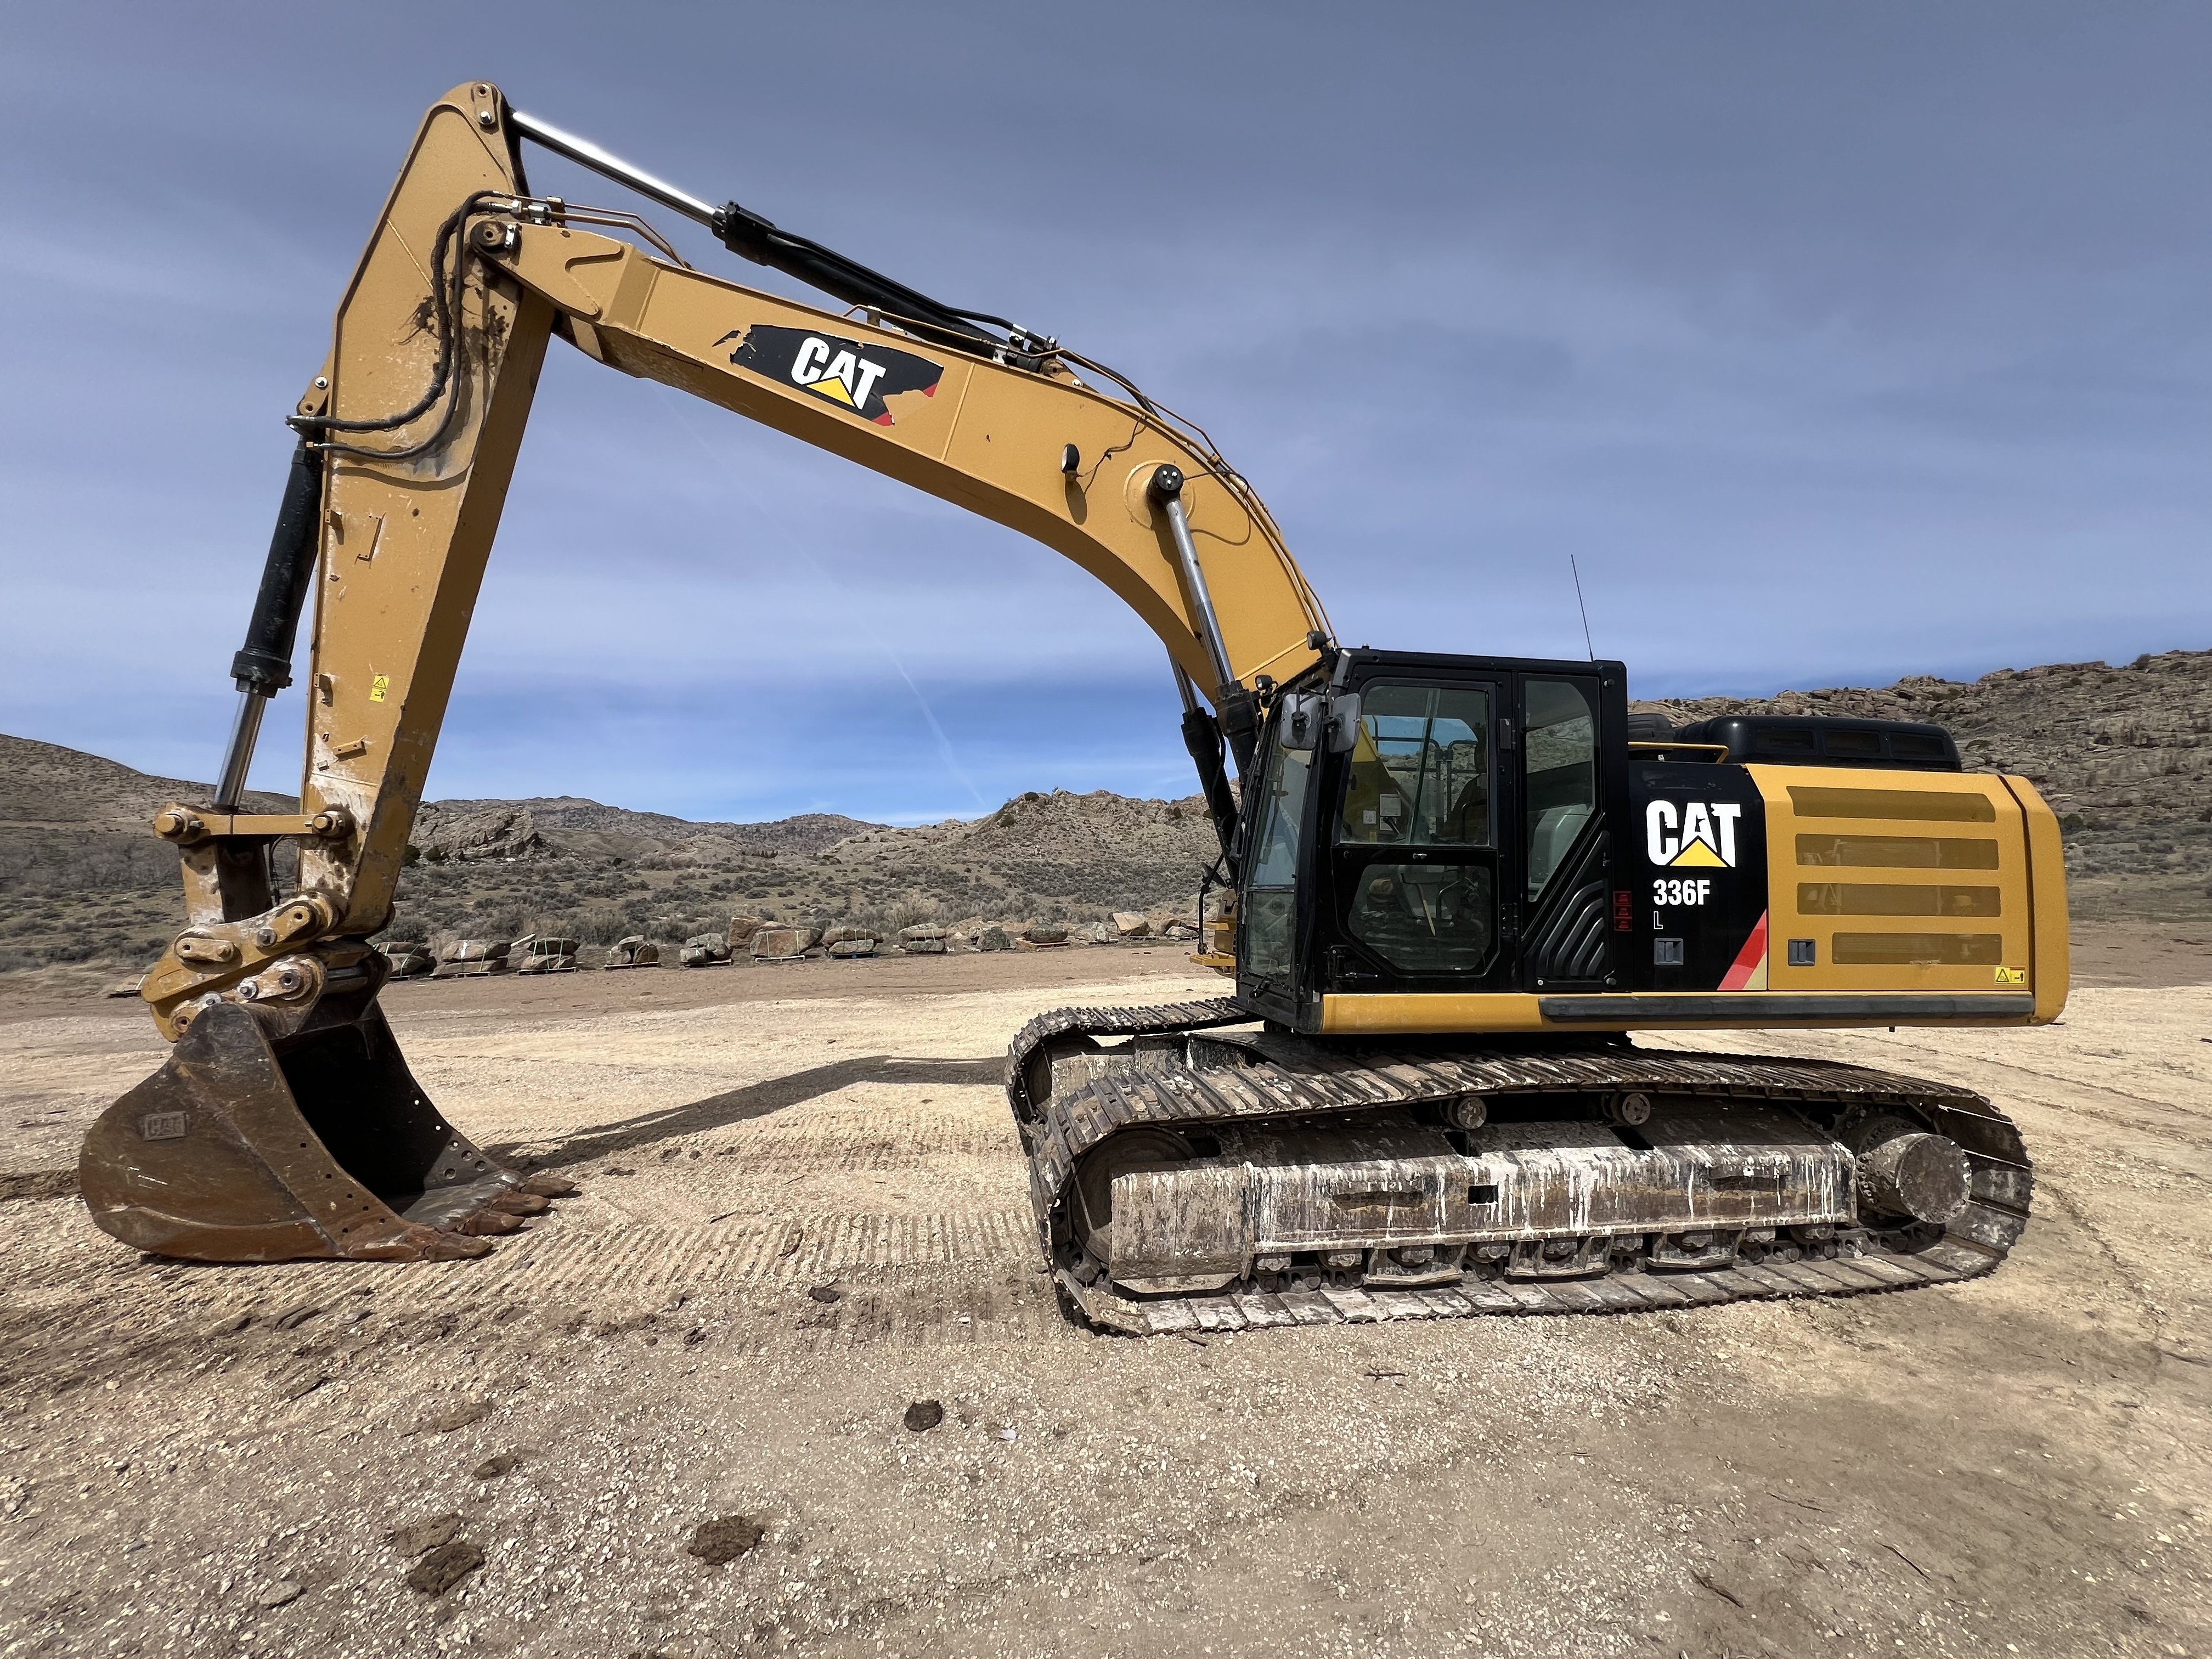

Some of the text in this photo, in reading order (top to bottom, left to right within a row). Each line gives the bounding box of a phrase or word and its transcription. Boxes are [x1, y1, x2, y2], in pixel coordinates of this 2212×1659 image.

[791, 337, 886, 410] CAT
[1646, 800, 1741, 867] CAT
[1654, 879, 1711, 905] 336F
[1654, 911, 1663, 929] L
